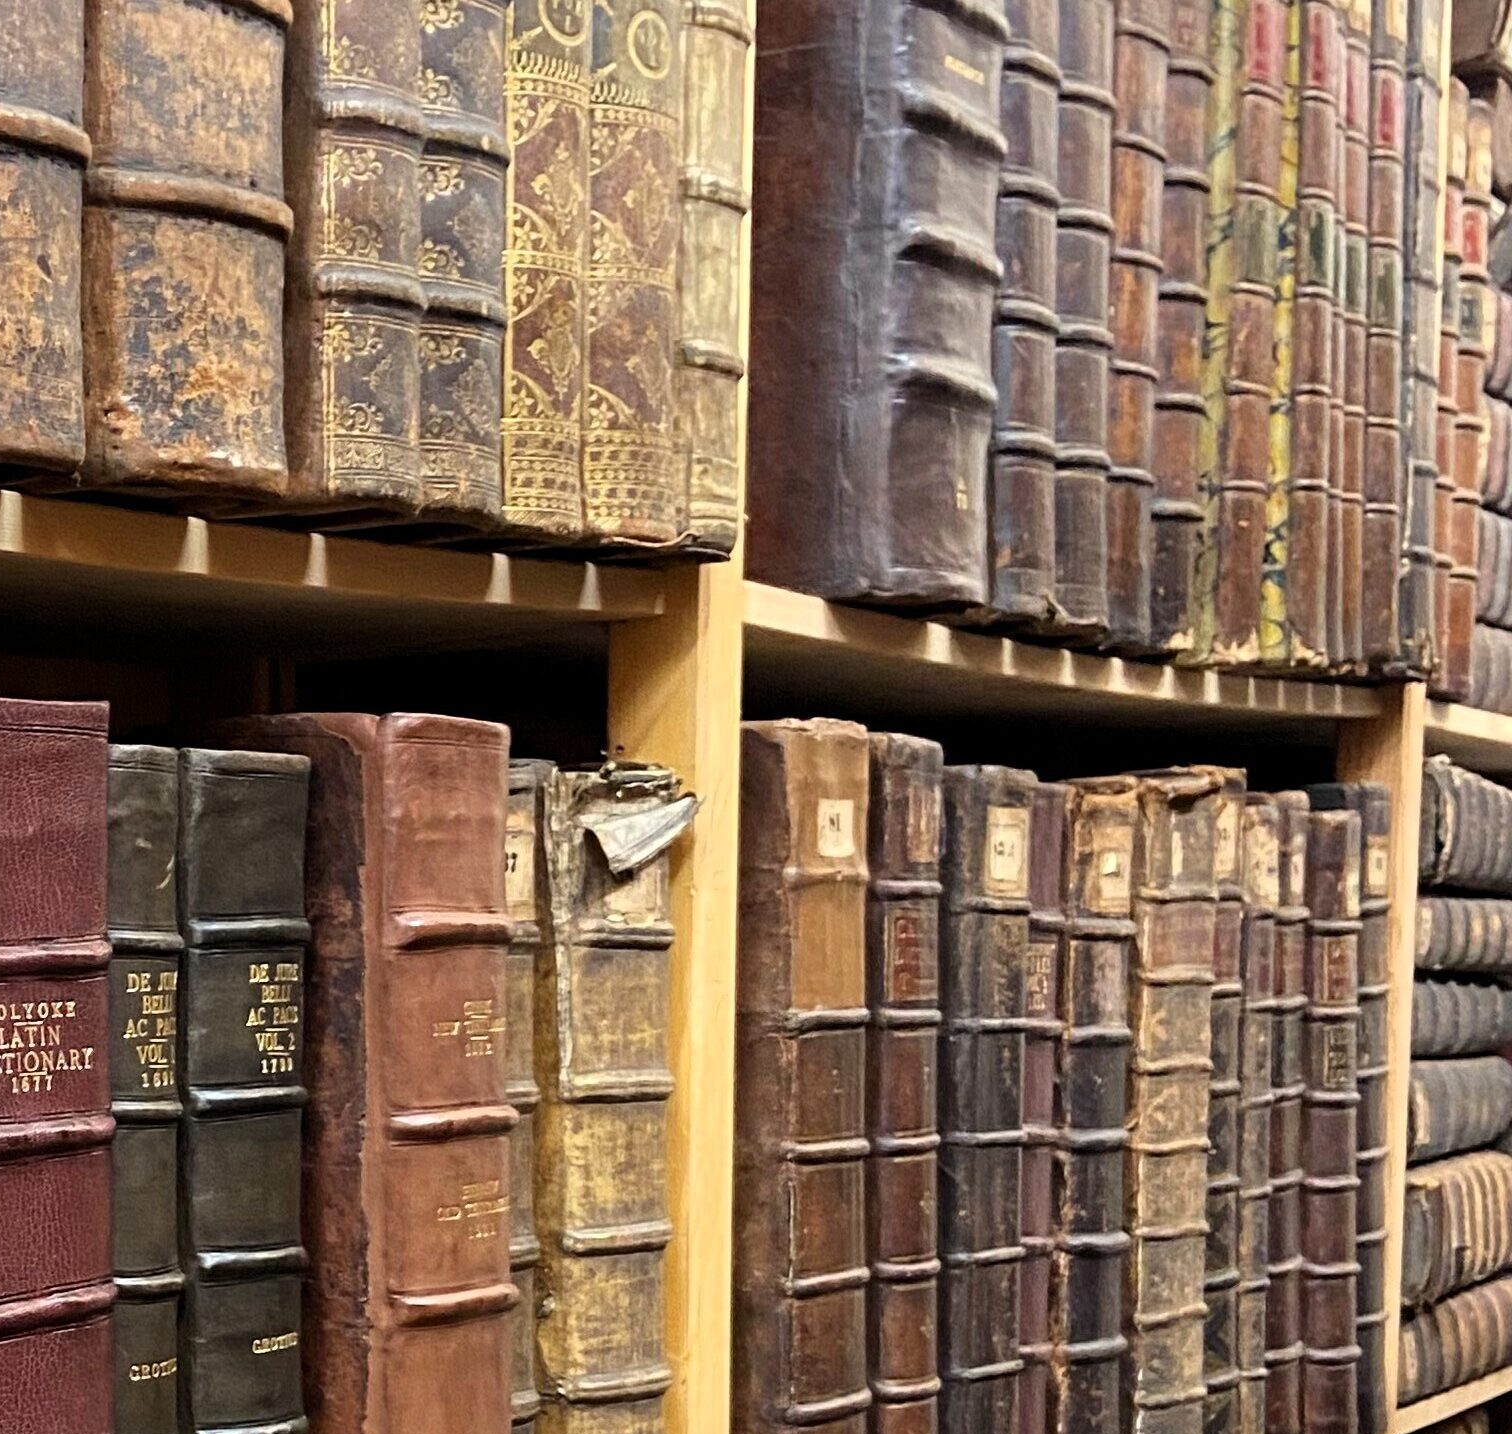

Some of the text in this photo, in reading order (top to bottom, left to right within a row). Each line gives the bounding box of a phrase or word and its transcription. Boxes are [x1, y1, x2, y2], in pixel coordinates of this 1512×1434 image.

[126, 971, 151, 993] DE
[249, 963, 270, 983] DE
[246, 1007, 267, 1027] AC
[123, 1018, 148, 1039] AC
[287, 1031, 297, 1051] 2
